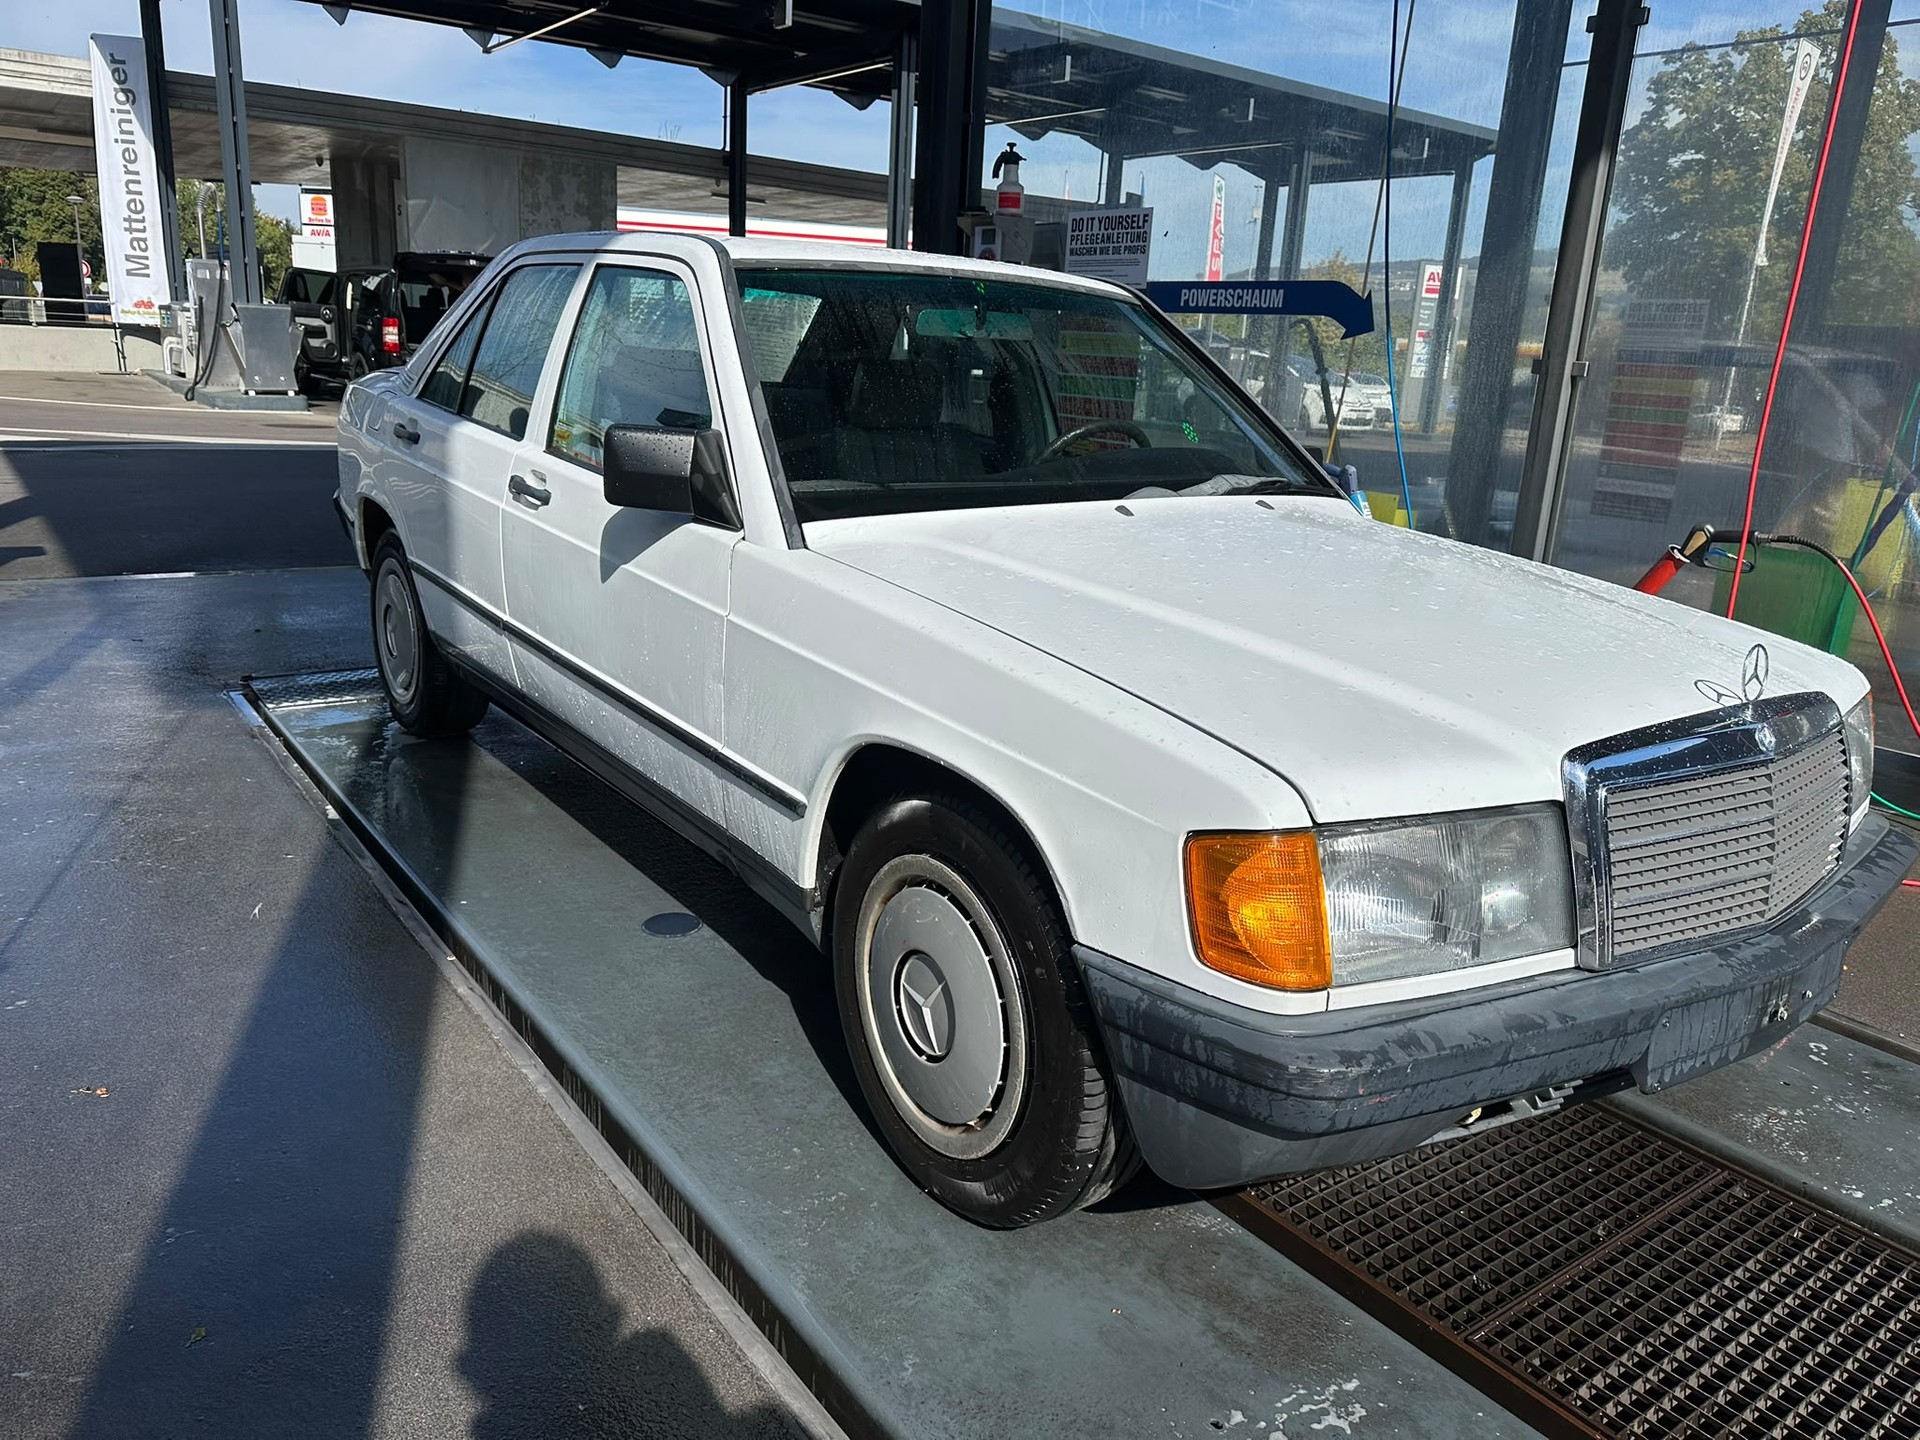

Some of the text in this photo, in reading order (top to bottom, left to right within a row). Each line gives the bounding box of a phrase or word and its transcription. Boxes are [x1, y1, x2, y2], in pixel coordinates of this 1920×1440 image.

[109, 52, 150, 278] Mattenreiniger
[1071, 213, 1149, 233] DO IT YOURSELF
[1069, 231, 1148, 246] PFLEGEANLEITUNG
[1069, 244, 1147, 256] WASCHEN WIE DIE PROFIS
[1180, 288, 1285, 308] POWERSCHAUM
